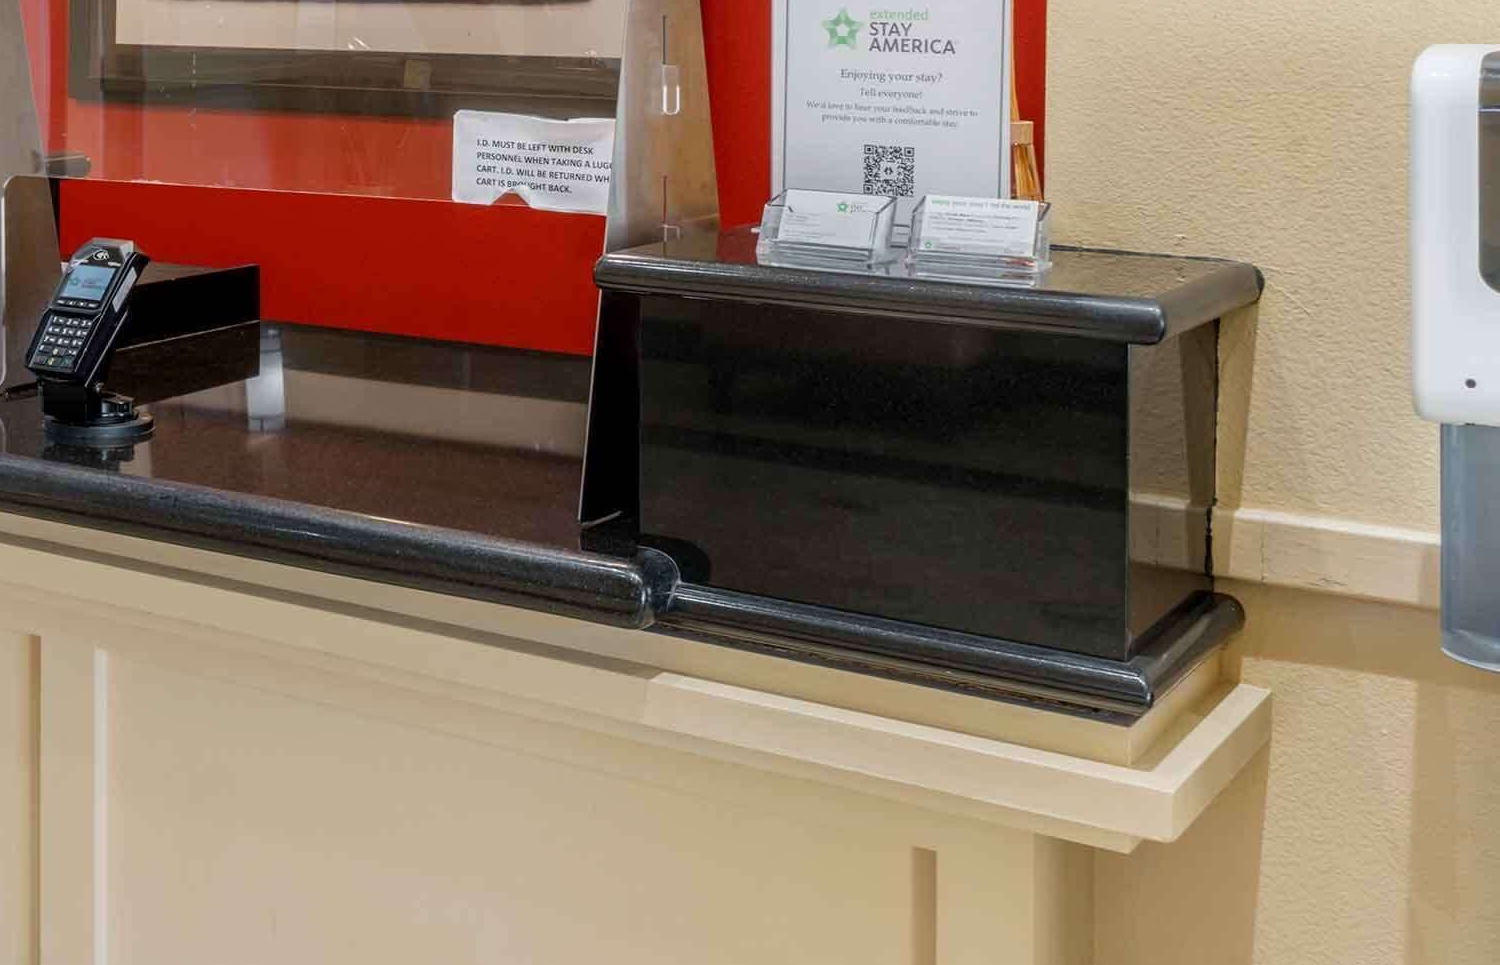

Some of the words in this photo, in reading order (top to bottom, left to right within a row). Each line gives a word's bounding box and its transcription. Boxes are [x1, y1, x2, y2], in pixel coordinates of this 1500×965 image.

[869, 7, 929, 21] extended
[869, 22, 913, 37] STAY
[868, 38, 956, 55] AMERICA
[840, 68, 886, 83] Enjoying
[888, 73, 912, 84] your
[915, 74, 944, 84] stay?
[860, 88, 876, 97] Tell
[878, 90, 923, 101] everyone!
[805, 100, 826, 109] We'd
[828, 102, 844, 110] love
[854, 103, 872, 112] hear
[873, 105, 891, 114] your
[892, 105, 927, 115] feedback
[929, 108, 945, 116] and
[946, 109, 968, 117] strive
[822, 112, 851, 123] provide
[852, 116, 868, 124] you
[869, 115, 887, 124] with
[894, 117, 940, 126] comfortable
[476, 139, 490, 147] I.D.
[492, 140, 515, 149] MUST
[517, 142, 526, 150] BE
[528, 143, 546, 151] LEFT
[548, 144, 571, 153] WITH
[572, 146, 594, 155] DESK
[476, 152, 522, 163] PERSONNEL
[524, 156, 550, 165] WHEN
[552, 158, 582, 168] TAKING
[476, 164, 500, 174] CART.
[500, 167, 514, 176] I.D.
[516, 168, 535, 177] WILL
[537, 170, 547, 178] BE
[549, 172, 592, 182] RETURNED
[476, 178, 496, 186] CART
[498, 180, 506, 188] IS
[548, 184, 572, 194] BACK.
